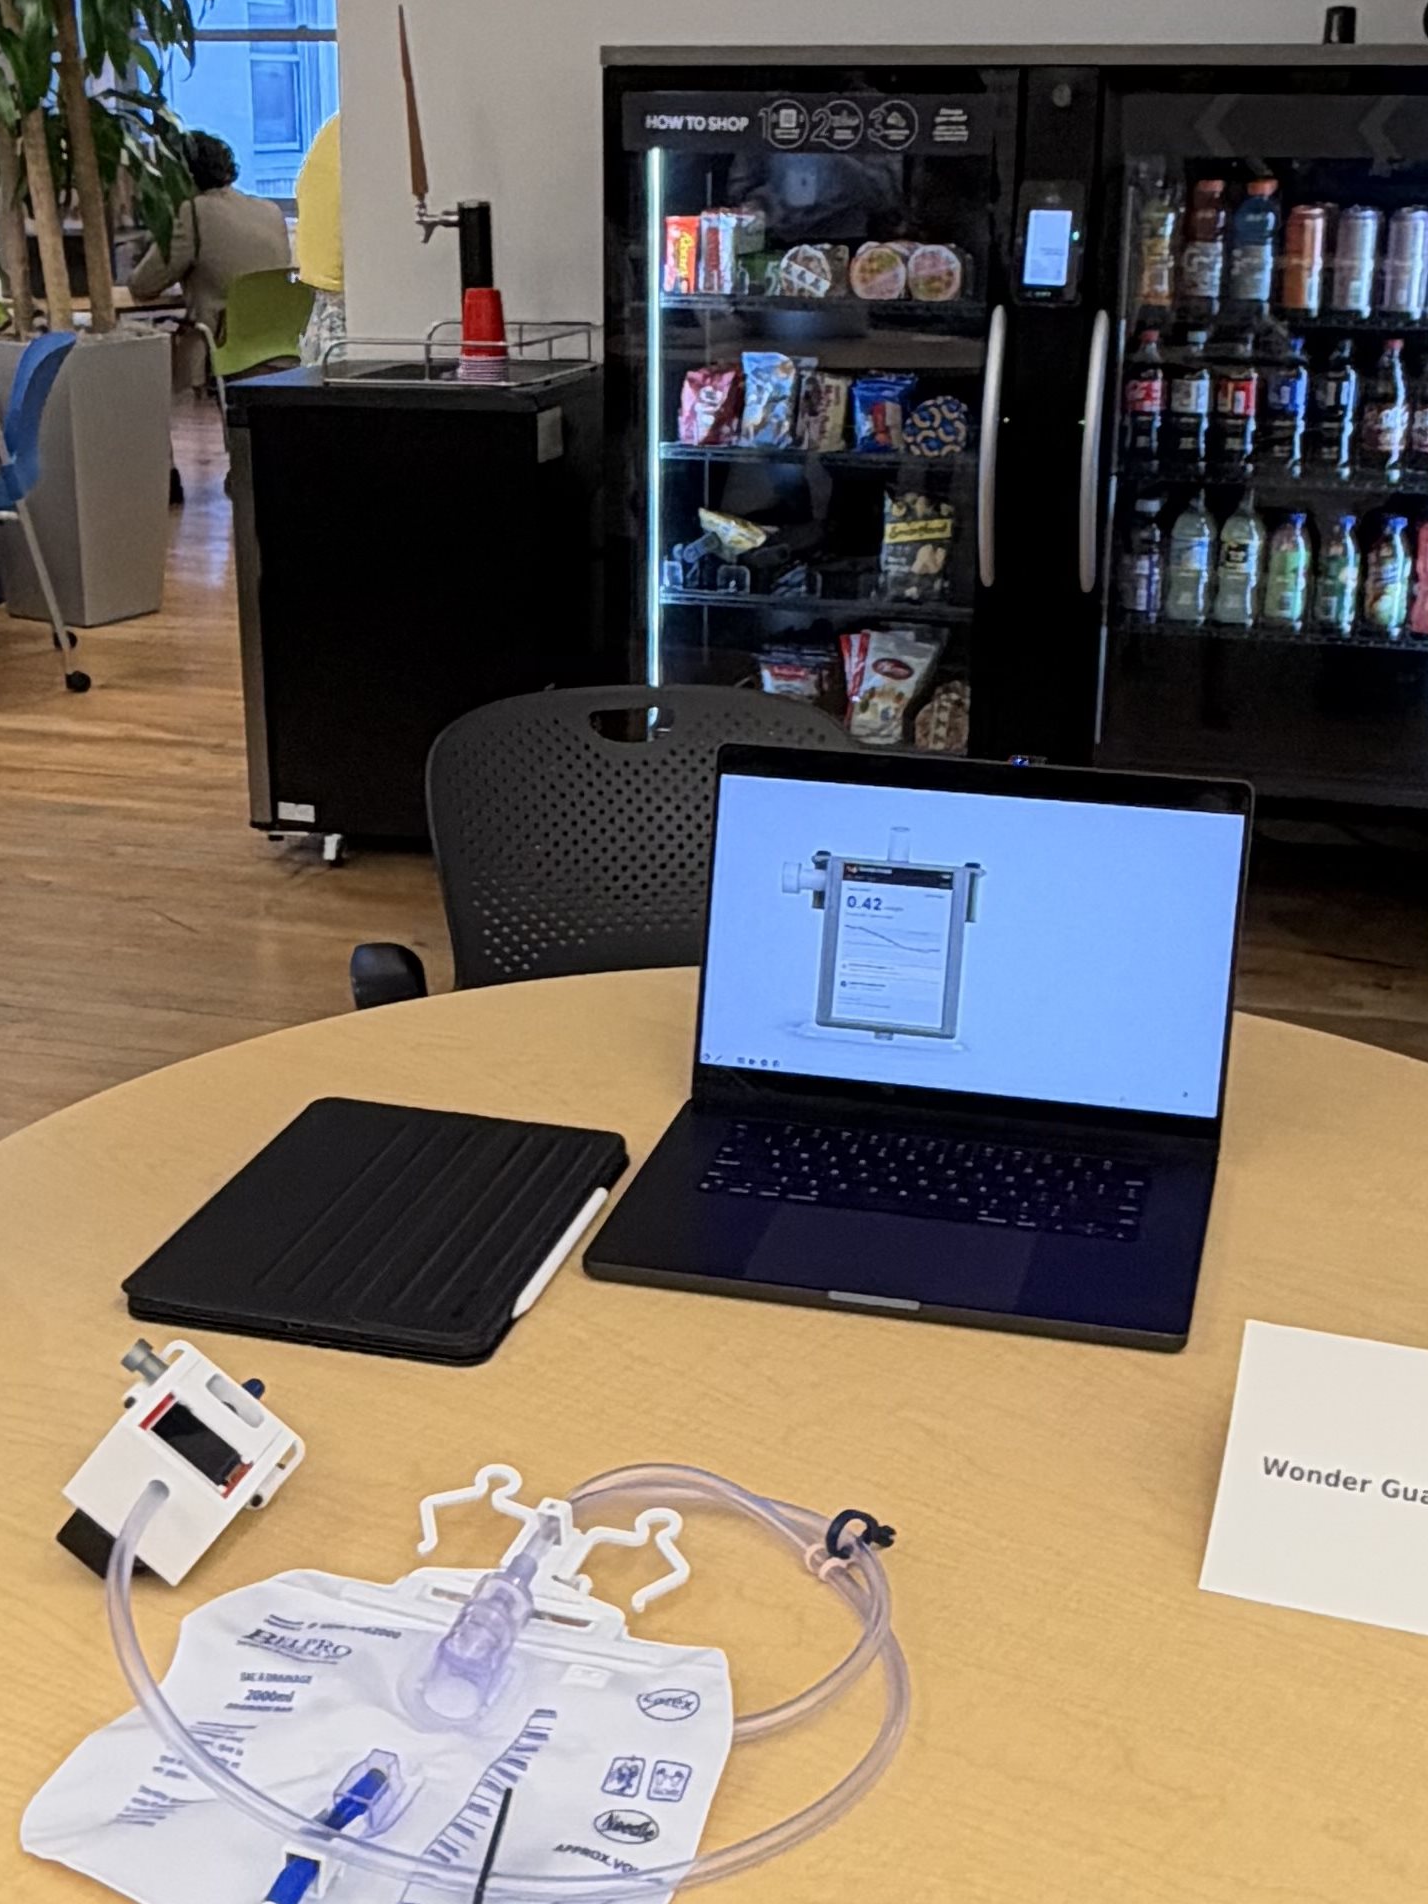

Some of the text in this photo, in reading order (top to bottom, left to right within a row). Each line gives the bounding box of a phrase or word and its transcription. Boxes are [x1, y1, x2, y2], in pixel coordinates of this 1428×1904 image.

[645, 114, 749, 132] HOW TO SHOP
[847, 895, 882, 911] 0.42
[1262, 1455, 1372, 1494] Wonder
[242, 1628, 353, 1659] BELPRO
